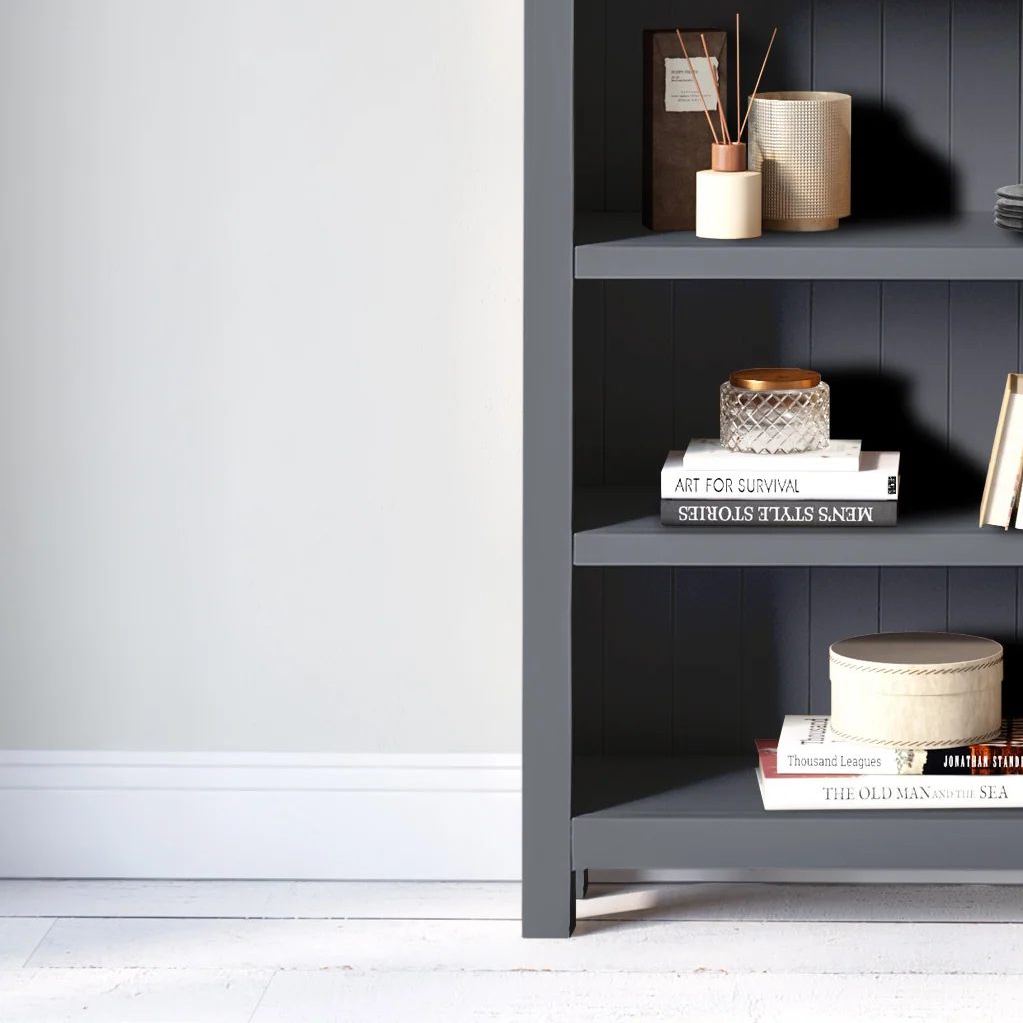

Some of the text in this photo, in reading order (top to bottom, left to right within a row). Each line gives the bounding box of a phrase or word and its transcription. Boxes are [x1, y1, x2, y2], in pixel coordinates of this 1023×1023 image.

[674, 478, 800, 493] ART FOR SURVIVAL
[678, 505, 874, 522] MEN'S STYLE STORIES
[787, 755, 882, 769] Thousand Leagues
[943, 755, 988, 768] JONATHAN
[823, 785, 1009, 800] THE OLD MAN AND THE SEA
